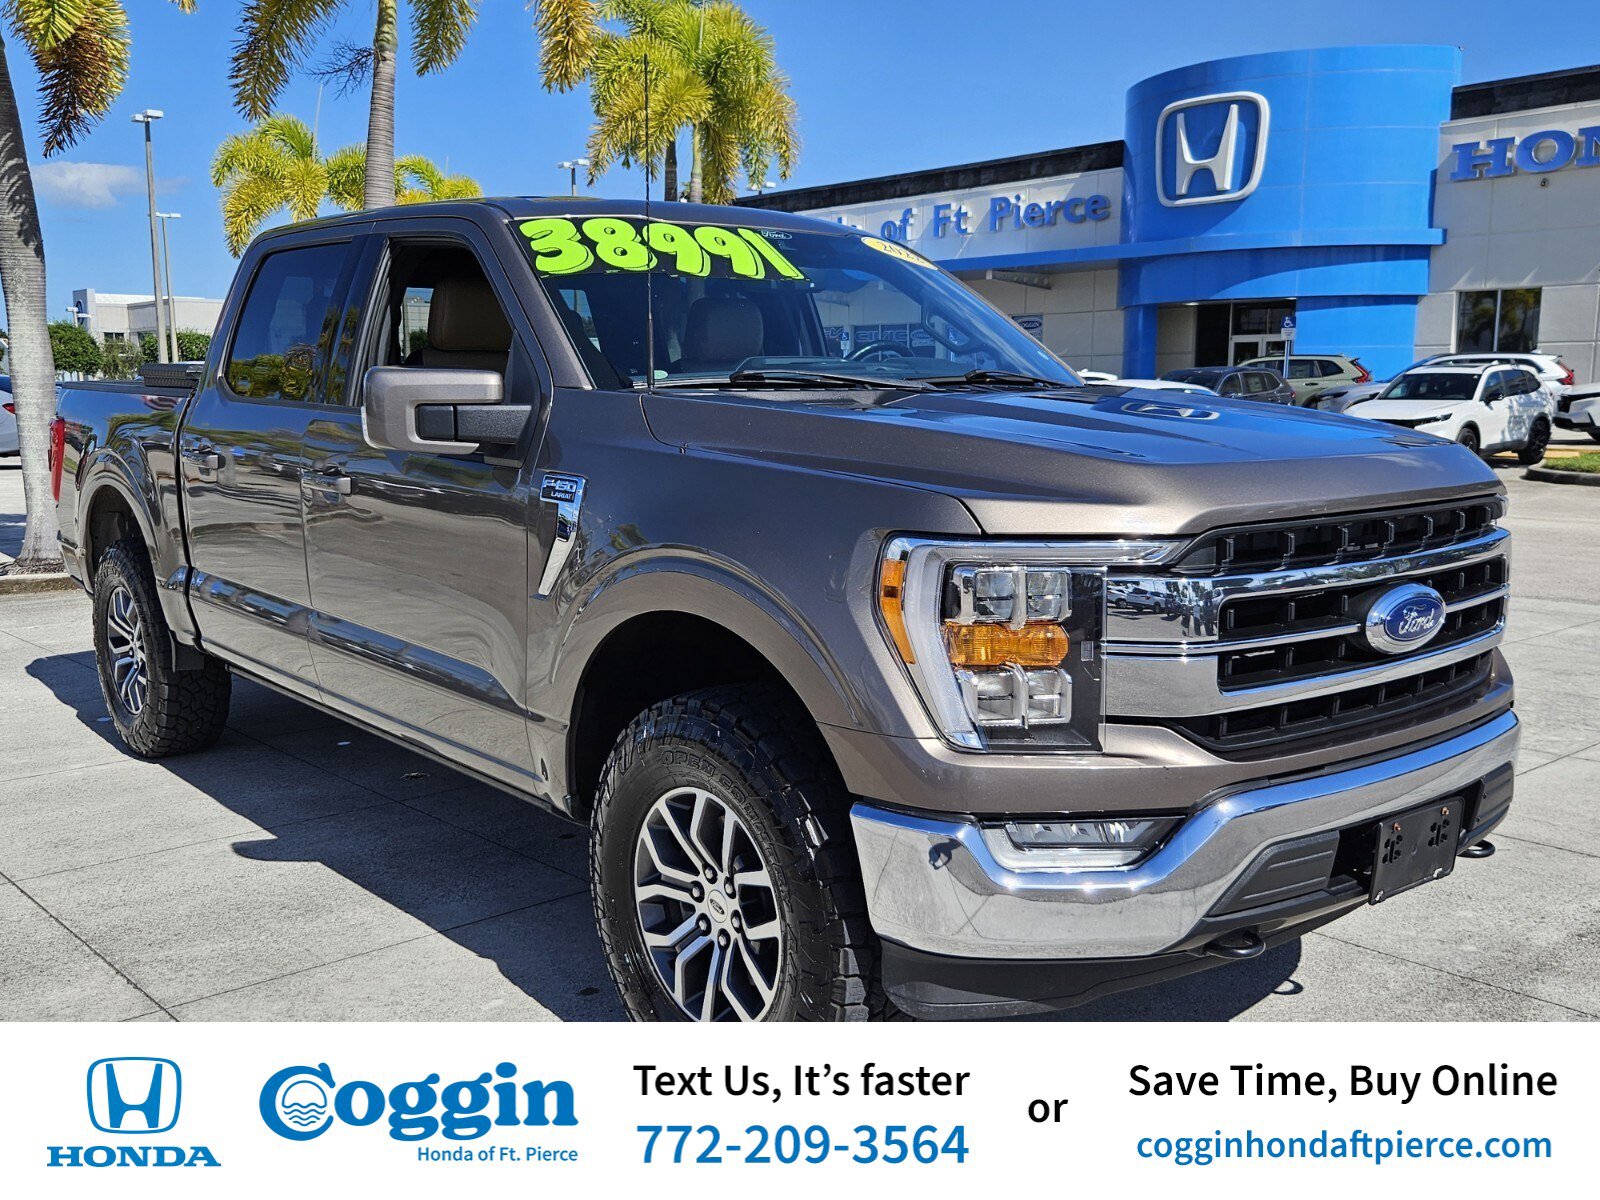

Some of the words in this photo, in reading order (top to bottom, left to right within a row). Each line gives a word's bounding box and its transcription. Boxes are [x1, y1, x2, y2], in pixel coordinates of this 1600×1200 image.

[880, 207, 914, 241] of
[933, 202, 971, 238] Ft
[989, 194, 1111, 232] Pierce
[519, 218, 805, 280] 38991
[543, 479, 577, 493] F-150
[550, 490, 573, 500] LARIAT
[1398, 604, 1435, 634] Ford
[661, 750, 717, 777] OPEN
